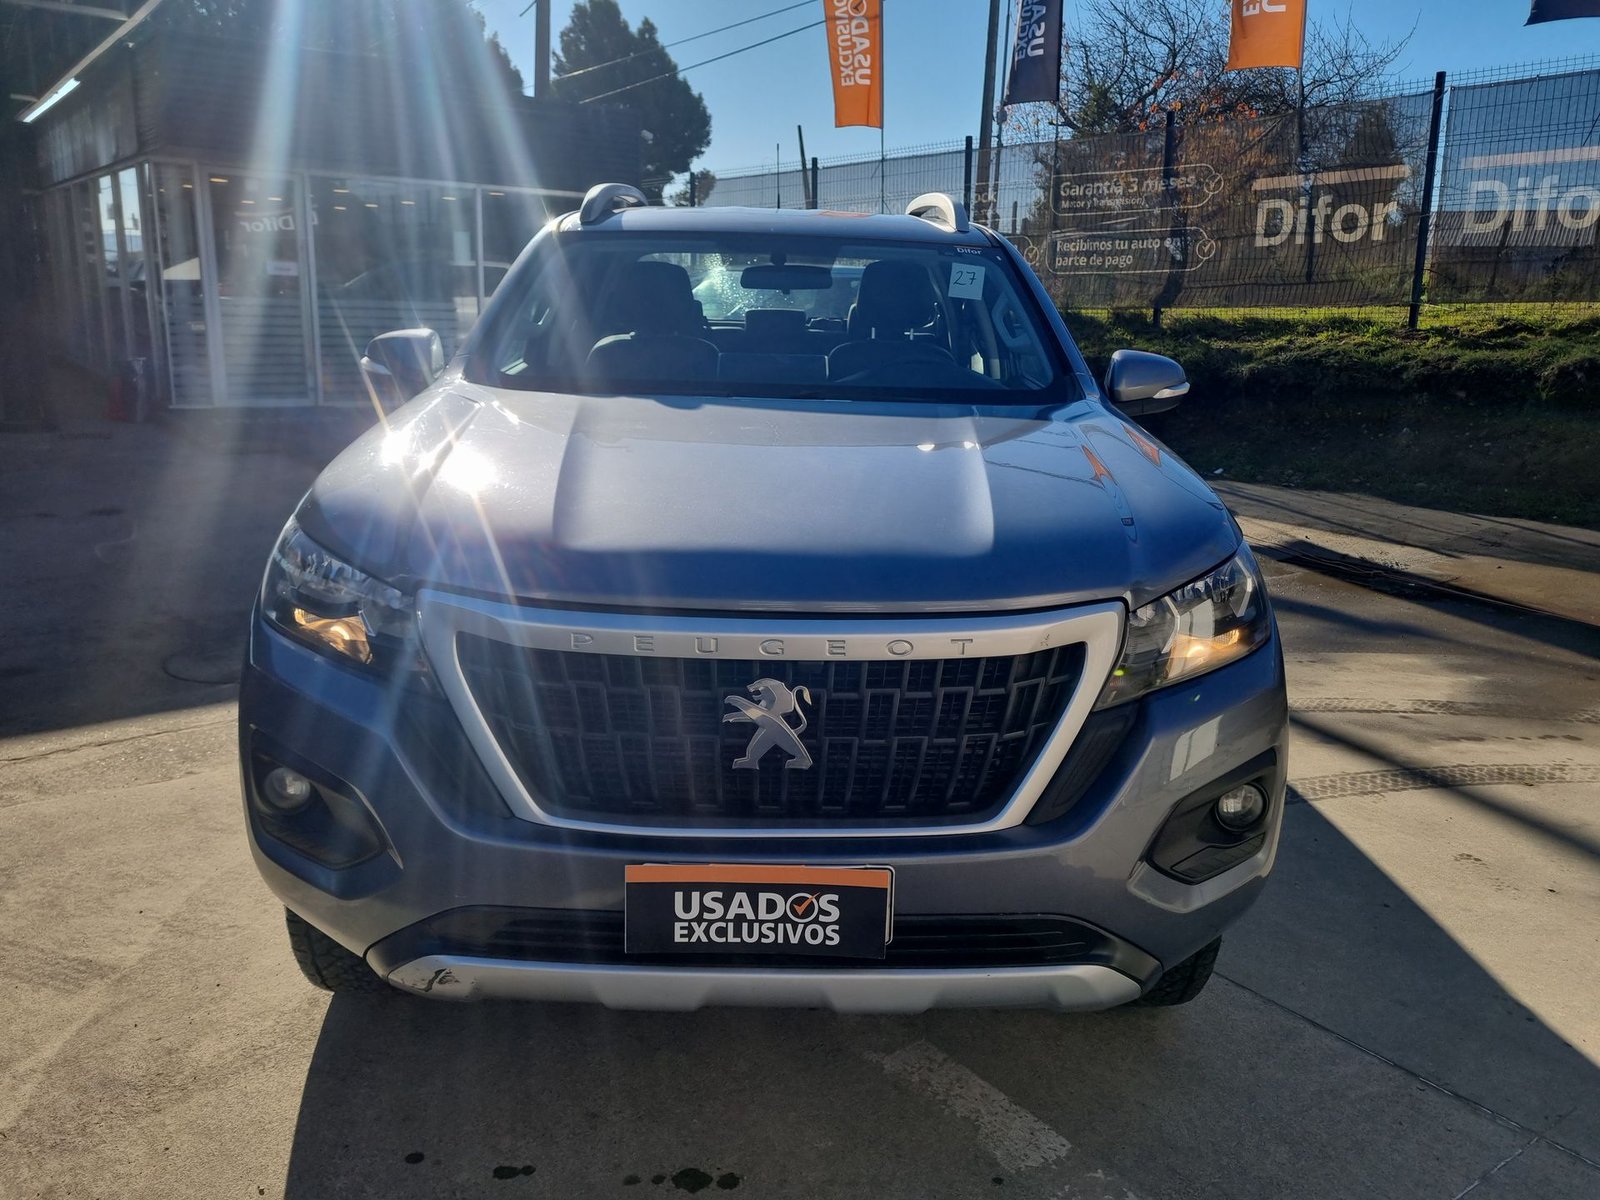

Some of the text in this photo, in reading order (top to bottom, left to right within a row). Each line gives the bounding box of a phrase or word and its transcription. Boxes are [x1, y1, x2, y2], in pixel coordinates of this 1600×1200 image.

[1127, 177, 1138, 192] 3
[1141, 176, 1196, 193] meses
[1254, 194, 1397, 247] Difor
[1057, 239, 1112, 251] Recibimos
[1115, 239, 1128, 249] tu
[1131, 238, 1160, 249] auto
[1055, 253, 1133, 268] parte de pago
[953, 270, 976, 286] 27
[570, 632, 974, 657] PEUGEOT
[674, 891, 840, 923] USADOS
[674, 922, 840, 946] EXCLUSIVOS
